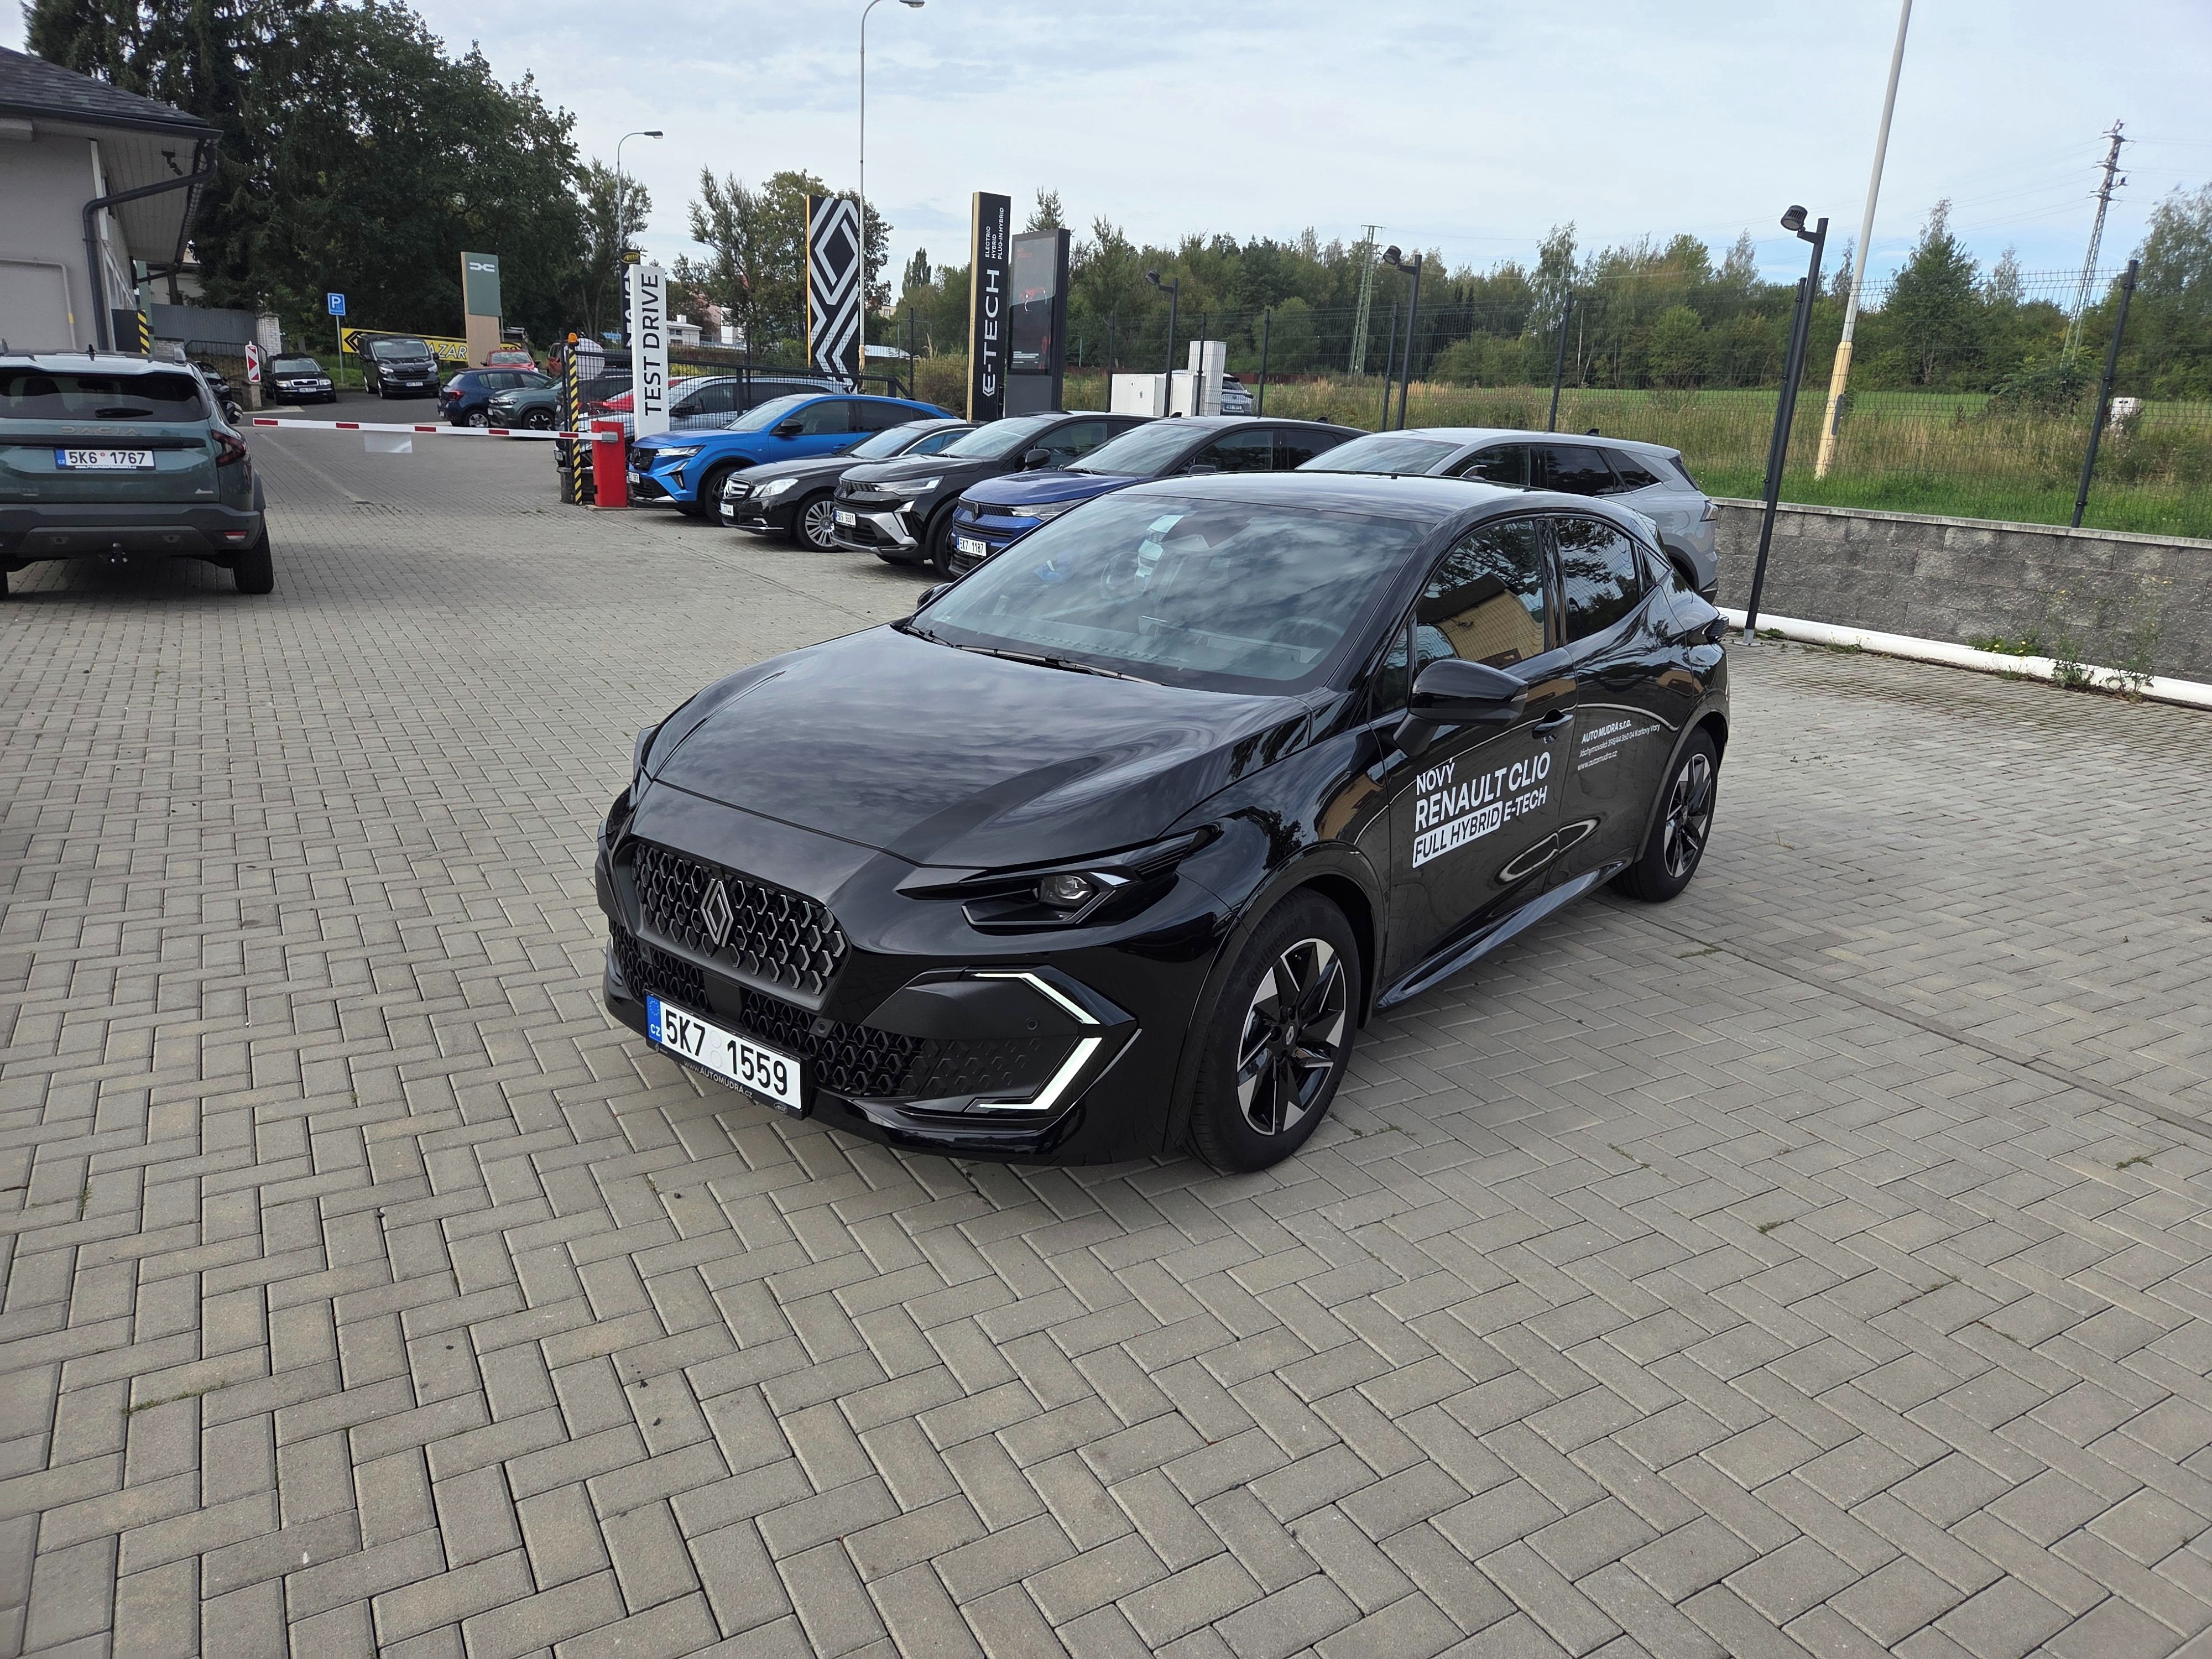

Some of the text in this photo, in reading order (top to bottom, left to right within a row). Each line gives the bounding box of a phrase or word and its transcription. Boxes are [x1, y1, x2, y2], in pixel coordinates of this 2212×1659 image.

[332, 296, 341, 308] P
[641, 273, 662, 416] TEST DRIVE
[983, 269, 999, 397] E-TECH
[62, 426, 139, 435] DACIA
[69, 451, 97, 465] 5K6
[111, 452, 145, 465] 1767
[960, 539, 983, 554] 5K7 1187
[1581, 729, 1598, 744] AUTO
[1598, 722, 1618, 738] MUDRA
[1415, 752, 1551, 832] RENAULT CLIO
[1416, 758, 1455, 795] NOVÝ
[1415, 785, 1548, 863] FULL HYBRID E-TECH
[650, 1009, 787, 1095] CZ 5K7 1559
[684, 1060, 753, 1099] www.AUTOMUDRA.cz
